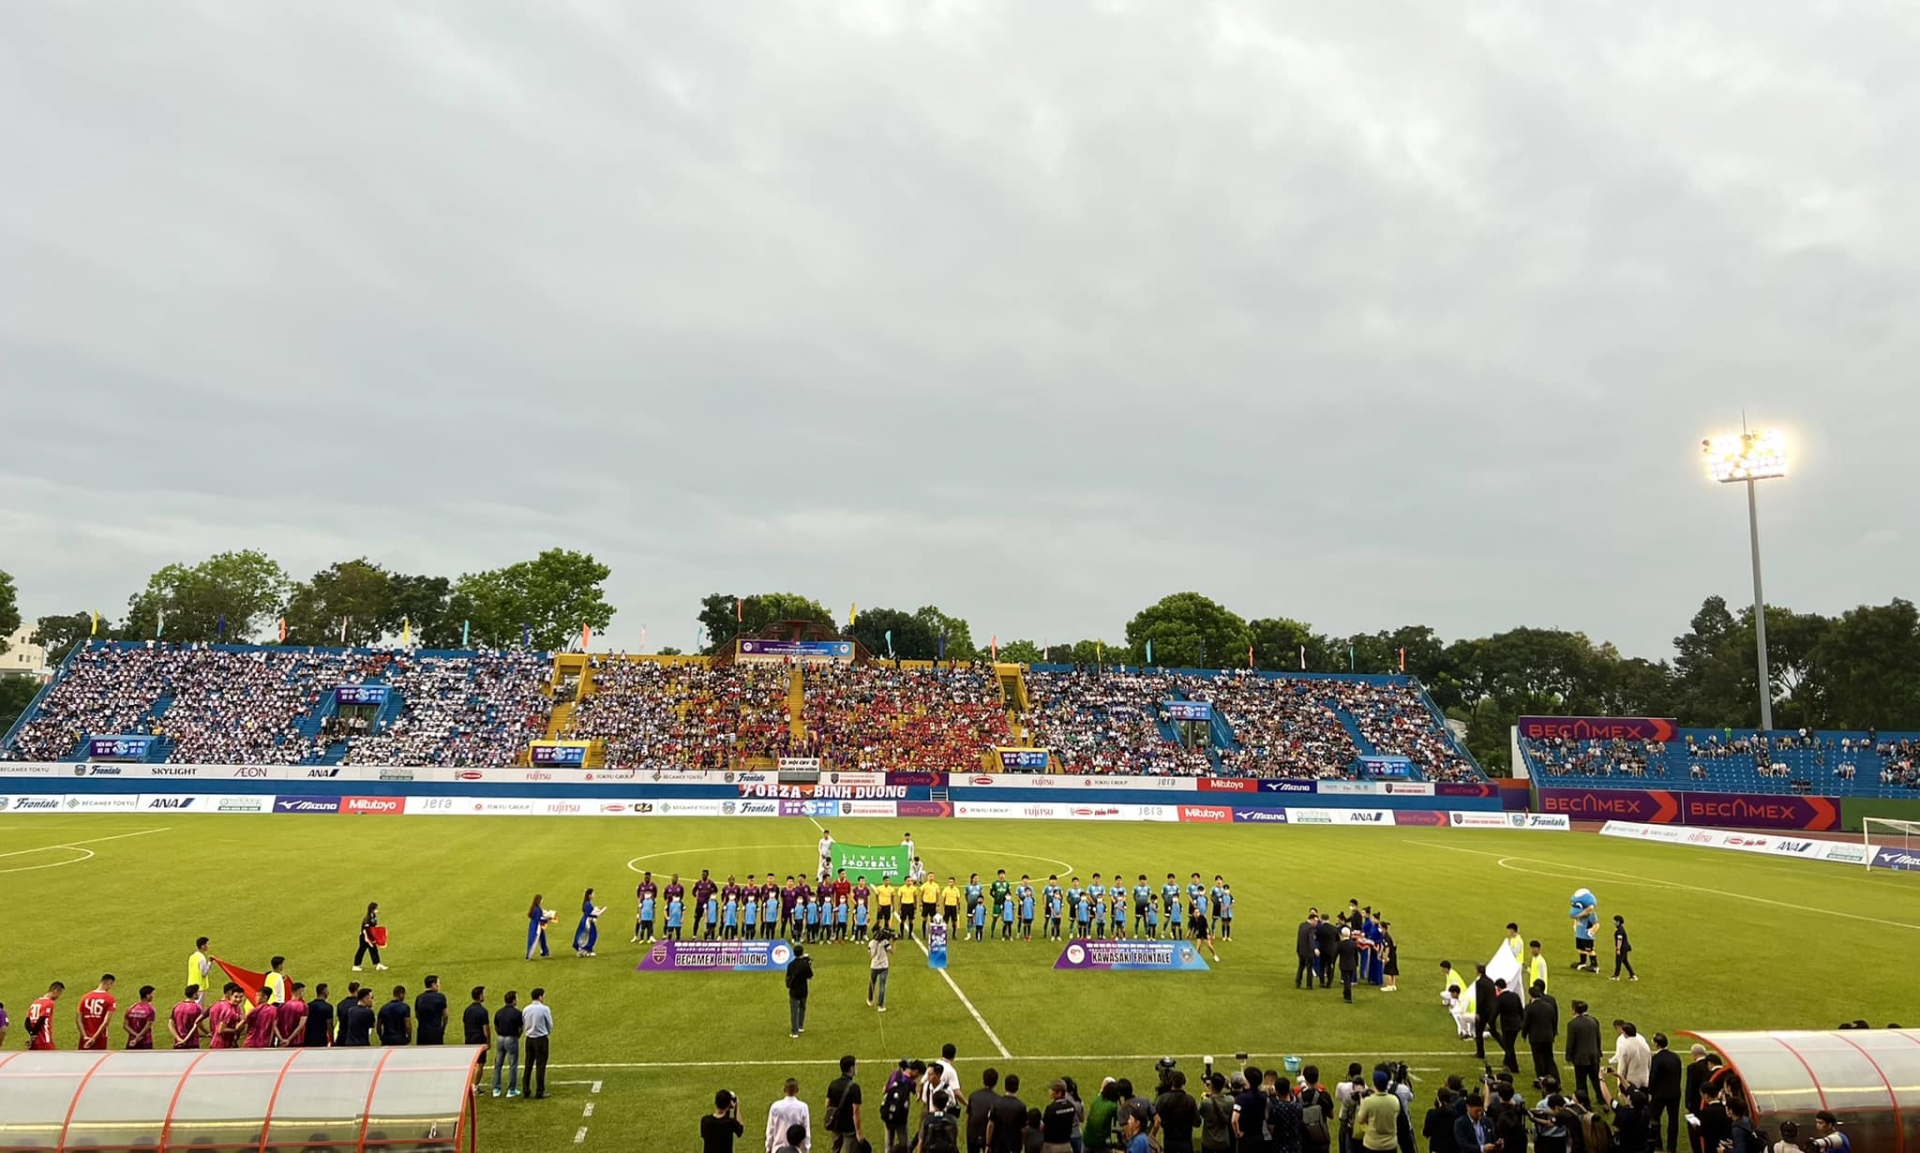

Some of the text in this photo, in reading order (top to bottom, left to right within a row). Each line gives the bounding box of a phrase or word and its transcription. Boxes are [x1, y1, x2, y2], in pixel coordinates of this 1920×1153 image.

[1529, 719, 1642, 738] BECAMEX
[90, 765, 121, 775] Frontale
[307, 769, 329, 777] ANA
[526, 771, 552, 780] FUJITSU
[738, 773, 765, 782] Frontale
[1032, 776, 1054, 786] FUJITSU
[1210, 780, 1244, 790] Mitutoyo
[741, 783, 907, 799] FORZA BINH DUONG
[13, 797, 59, 809] Frontale
[148, 798, 179, 808] ANA
[348, 799, 396, 811] Mitutoyo
[547, 802, 580, 813] FUJITSU
[740, 802, 775, 813] Frontale
[1545, 793, 1641, 813] BECAMEX
[1690, 798, 1795, 819] BECAMEX
[1024, 806, 1053, 816] FUJITSU
[1184, 808, 1225, 819] Mitutoyo
[1350, 812, 1373, 821] ANA
[1530, 815, 1566, 826] Frontale
[1777, 841, 1800, 852] ANA
[675, 953, 715, 965] BECAMEX
[1092, 952, 1171, 964] KAWASAKI FRONTALE
[84, 999, 104, 1015] 46
